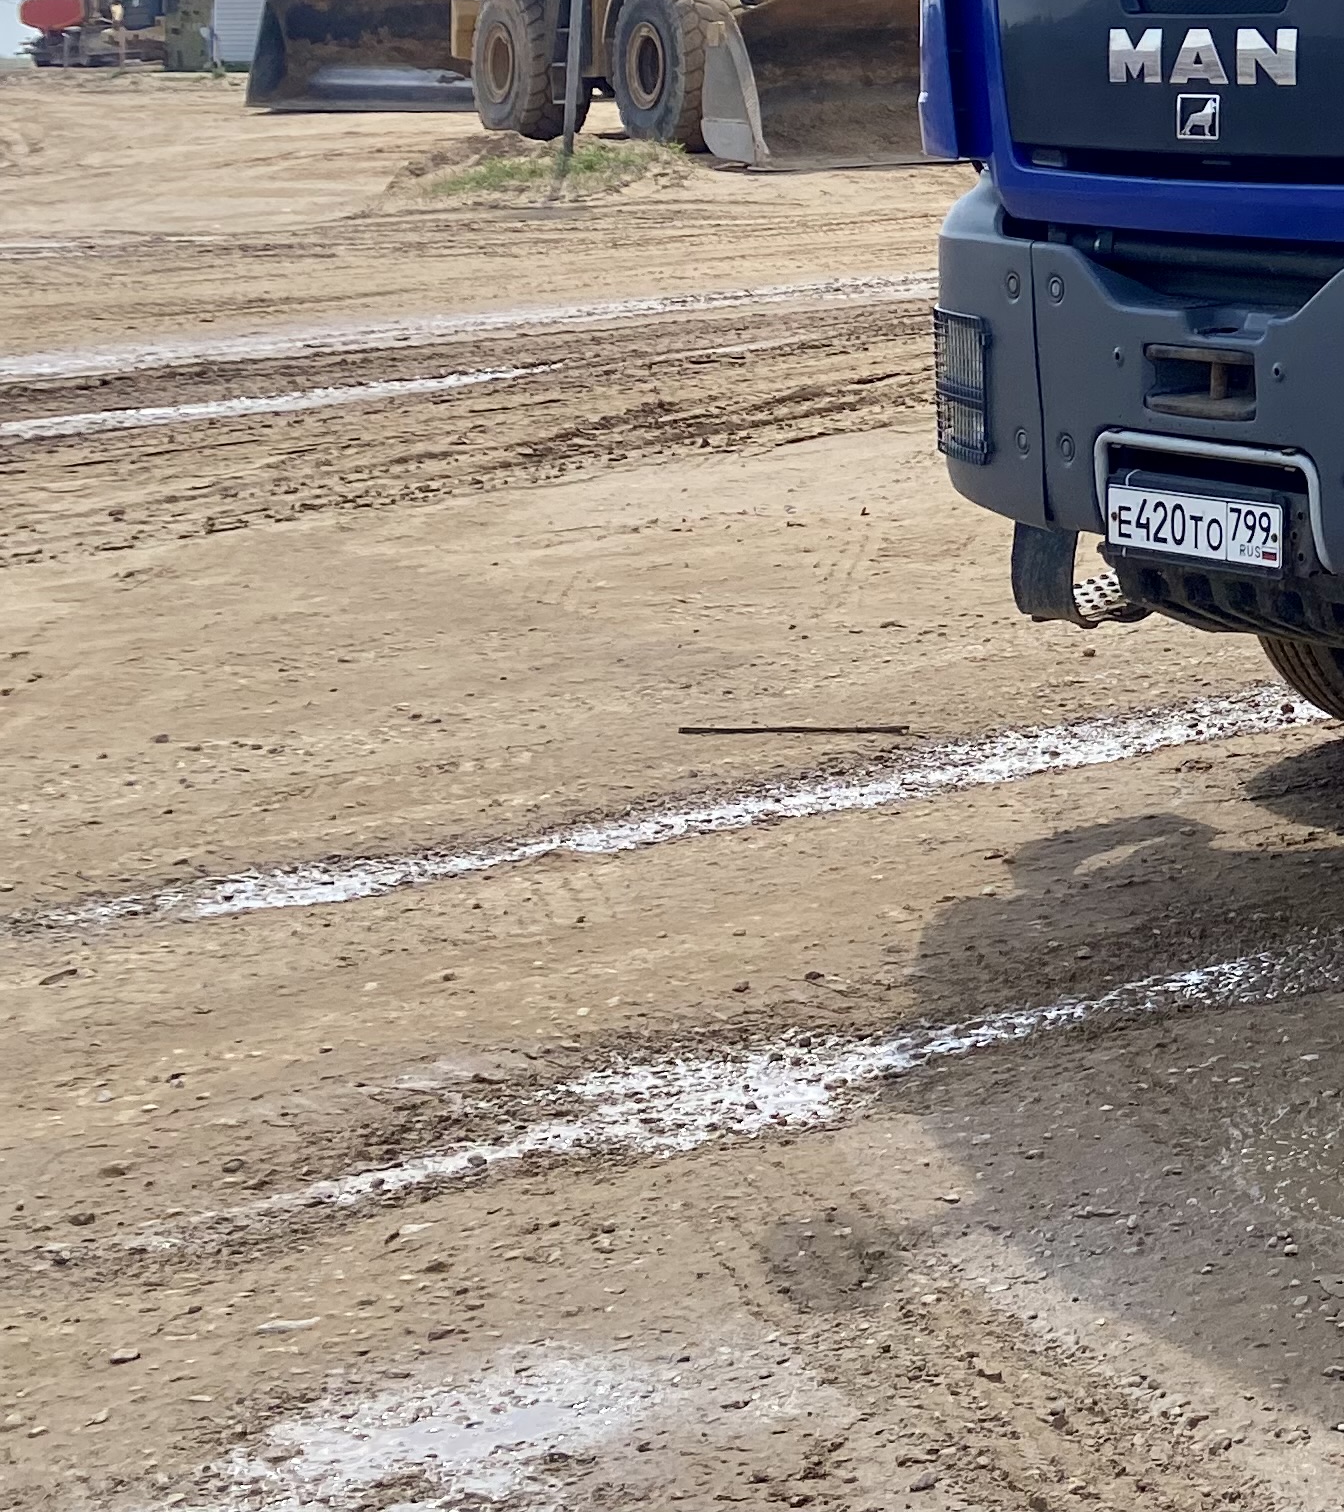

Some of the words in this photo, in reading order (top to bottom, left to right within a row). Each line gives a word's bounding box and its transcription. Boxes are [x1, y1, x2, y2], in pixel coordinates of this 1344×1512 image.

[1109, 28, 1298, 85] MAN
[1229, 506, 1272, 546] 799
[1239, 543, 1261, 559] RUS
